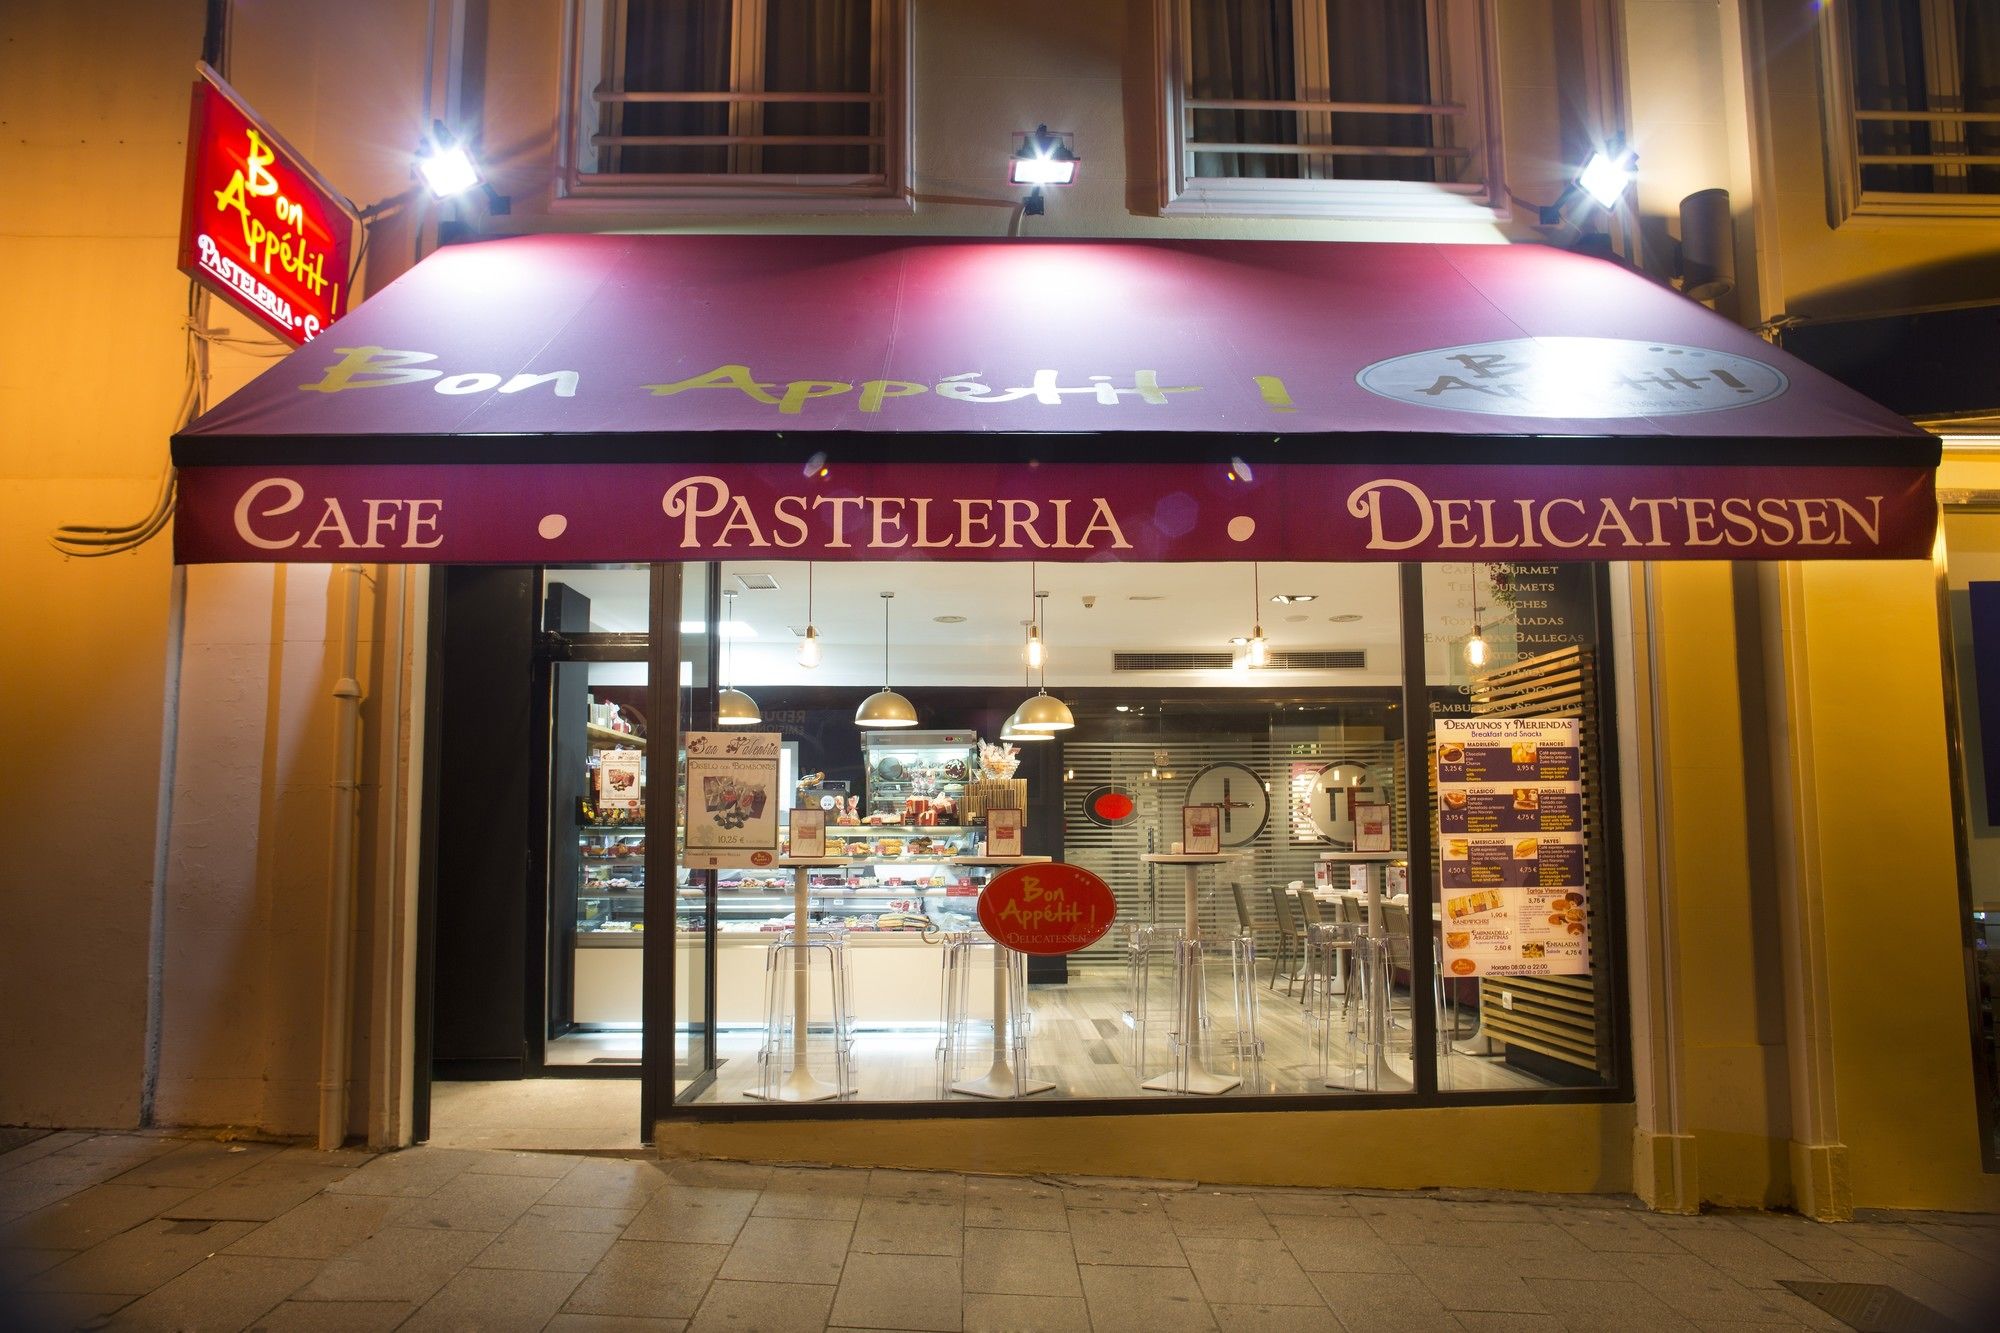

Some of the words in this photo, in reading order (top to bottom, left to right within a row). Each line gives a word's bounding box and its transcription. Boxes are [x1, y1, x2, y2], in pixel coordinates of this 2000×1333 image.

[247, 129, 302, 235] Bon
[213, 169, 328, 295] Appétit
[197, 233, 293, 326] PASTELERIA
[298, 346, 580, 397] Bon
[639, 365, 1203, 414] Appétit
[234, 477, 444, 549] CAFE
[662, 475, 1134, 549] PASTELERIA
[1347, 478, 1884, 550] DELICATESSEN
[1443, 719, 1502, 730] DESAYUNOS
[1505, 721, 1512, 730] Y
[1513, 719, 1573, 730] MERIENDAS
[1471, 730, 1503, 738] Breakfast
[1505, 730, 1518, 738] and
[1519, 730, 1542, 738] Snacks
[998, 898, 1083, 930] Appétit
[1021, 876, 1064, 903] Bon
[1007, 932, 1088, 944] DELICATESSEN
